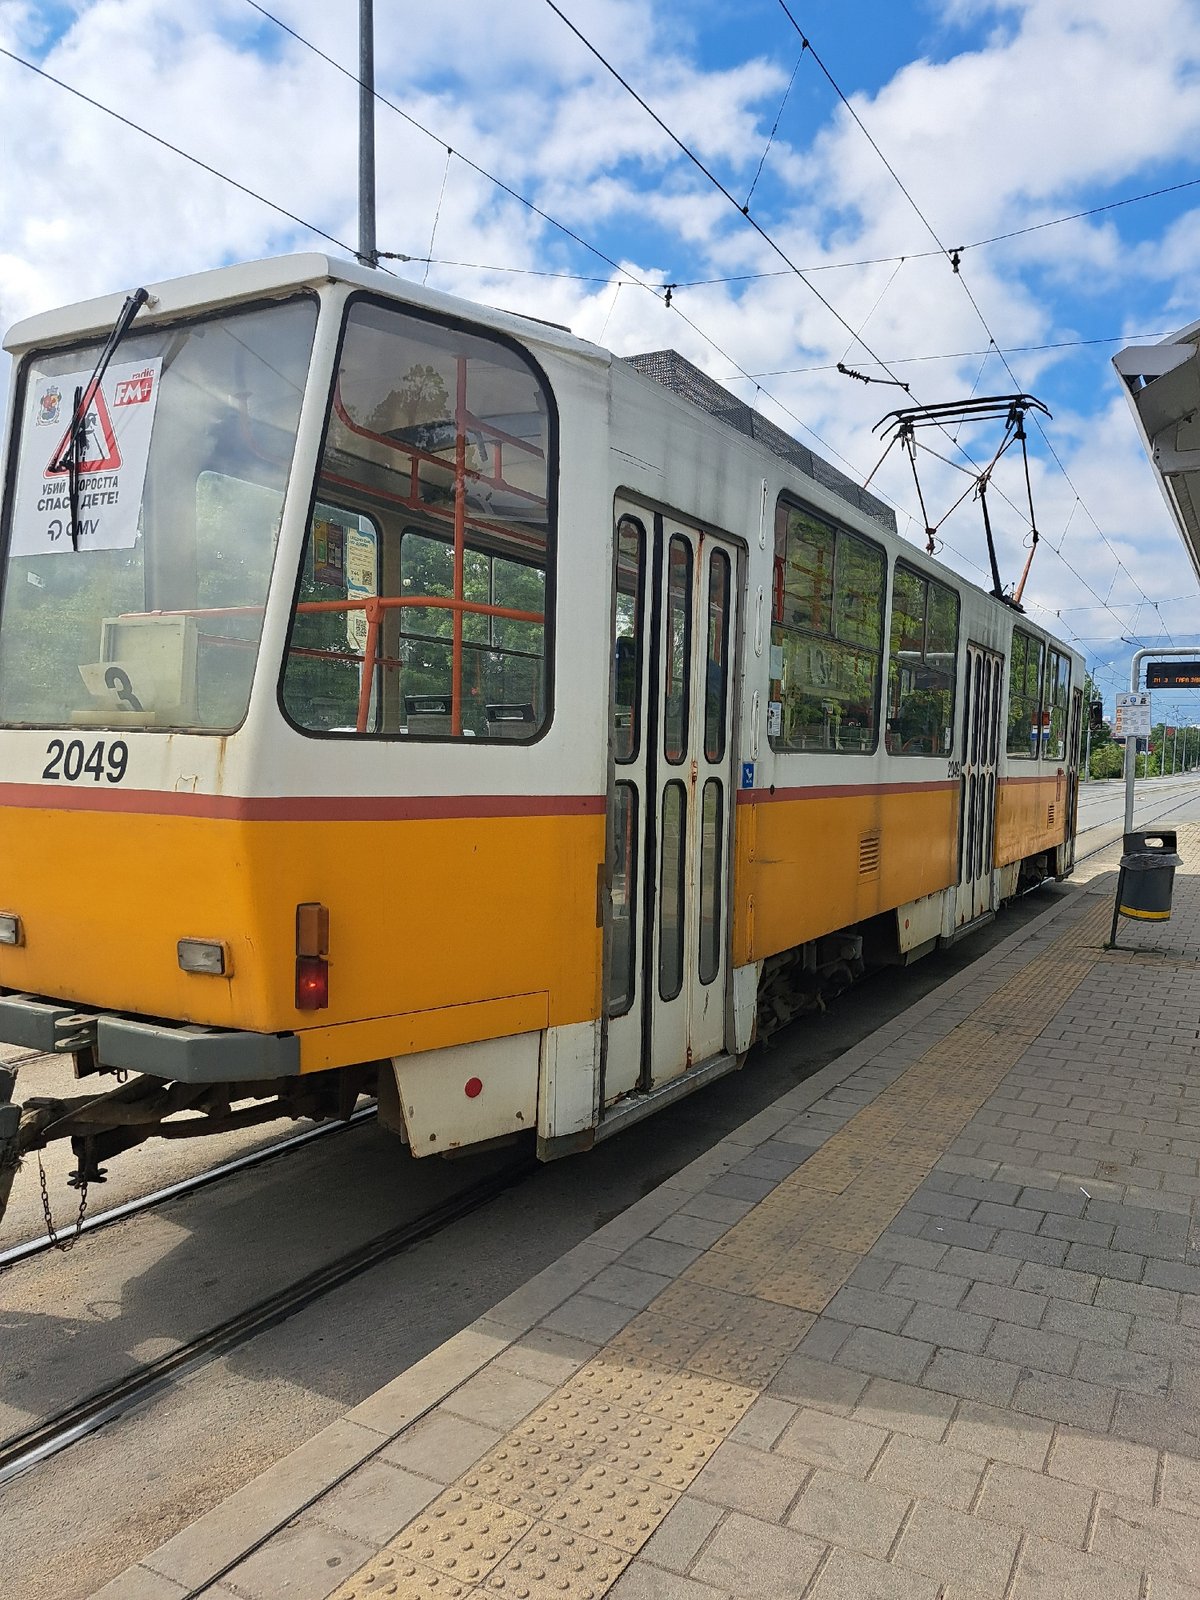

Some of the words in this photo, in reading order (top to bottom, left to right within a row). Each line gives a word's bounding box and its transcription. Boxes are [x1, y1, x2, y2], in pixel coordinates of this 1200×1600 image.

[132, 367, 155, 379] radio
[42, 479, 66, 496] УБИЙ
[69, 476, 119, 493] ОРОСТТА
[37, 496, 78, 512] СПАС
[80, 491, 119, 511] ДЕТЕ!
[104, 666, 144, 712] 3
[42, 739, 129, 784] 2049
